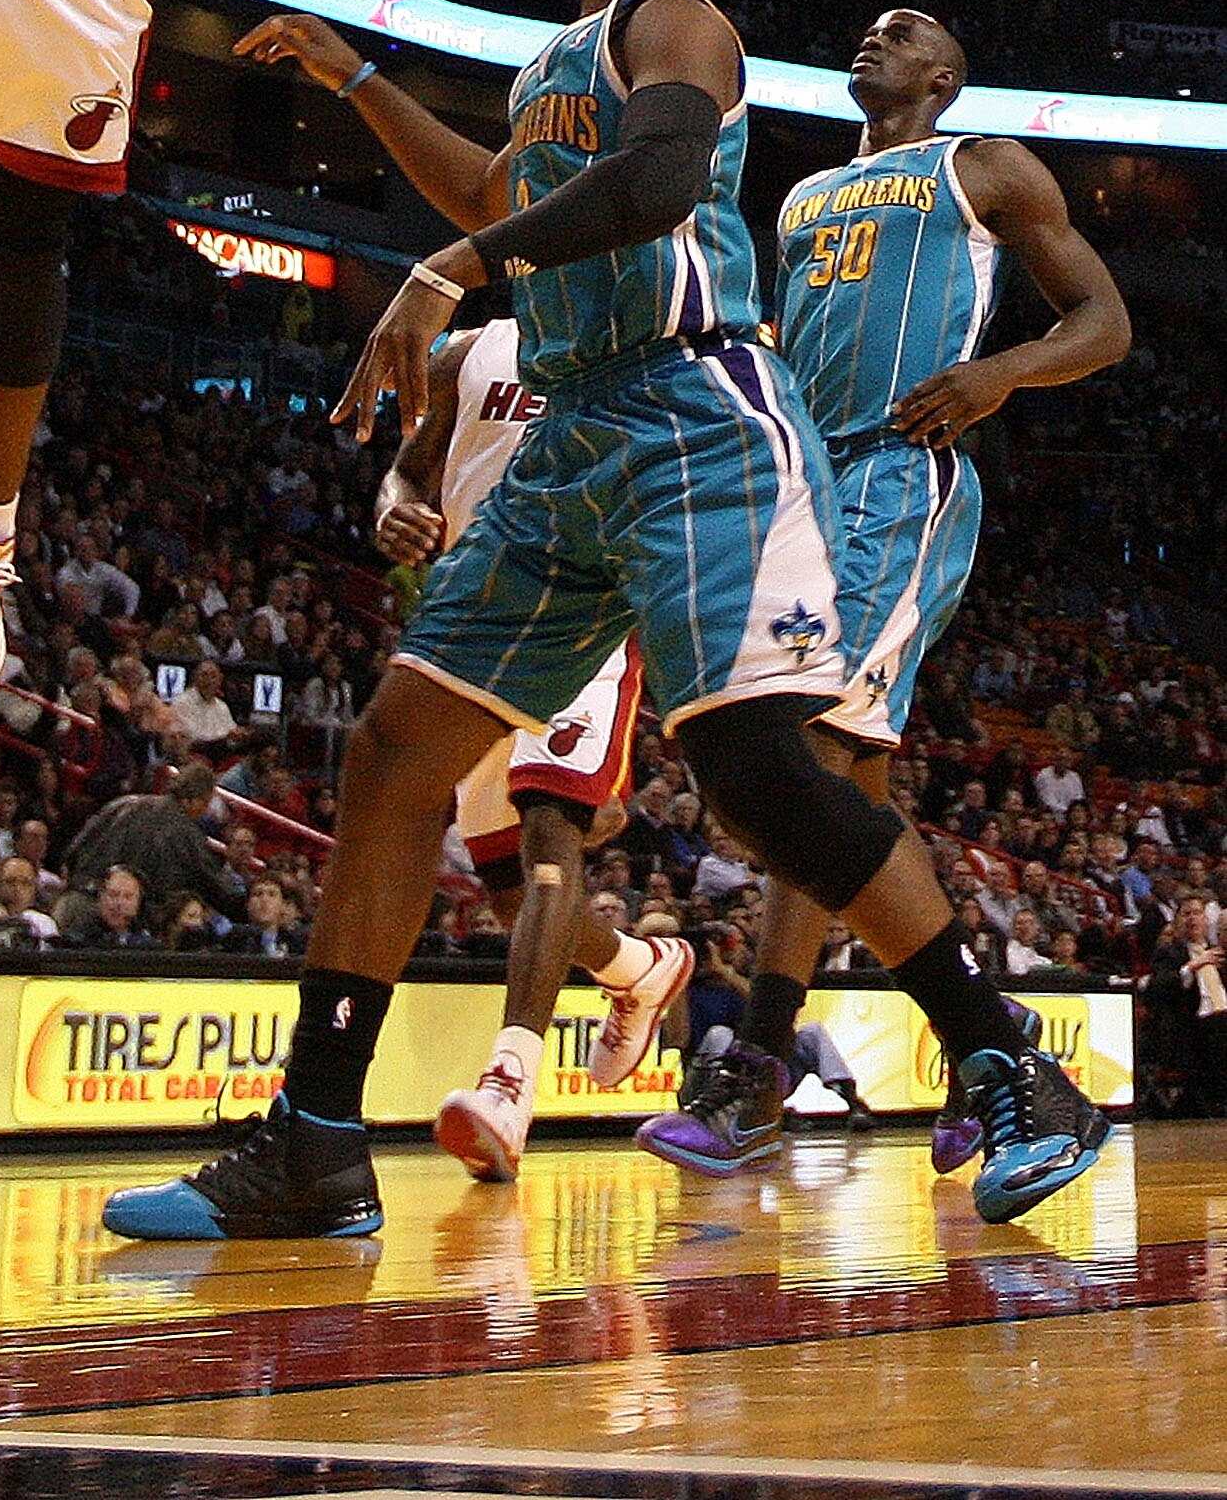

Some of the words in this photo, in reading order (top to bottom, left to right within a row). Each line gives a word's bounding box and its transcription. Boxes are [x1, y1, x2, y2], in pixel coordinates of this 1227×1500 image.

[784, 190, 832, 235] NEW
[831, 174, 939, 214] ORLEANS
[807, 219, 879, 289] 50
[64, 1011, 190, 1071] TIRES
[197, 1011, 294, 1071] PLU
[65, 1074, 155, 1103] TOTAL
[166, 1074, 221, 1100] CAR
